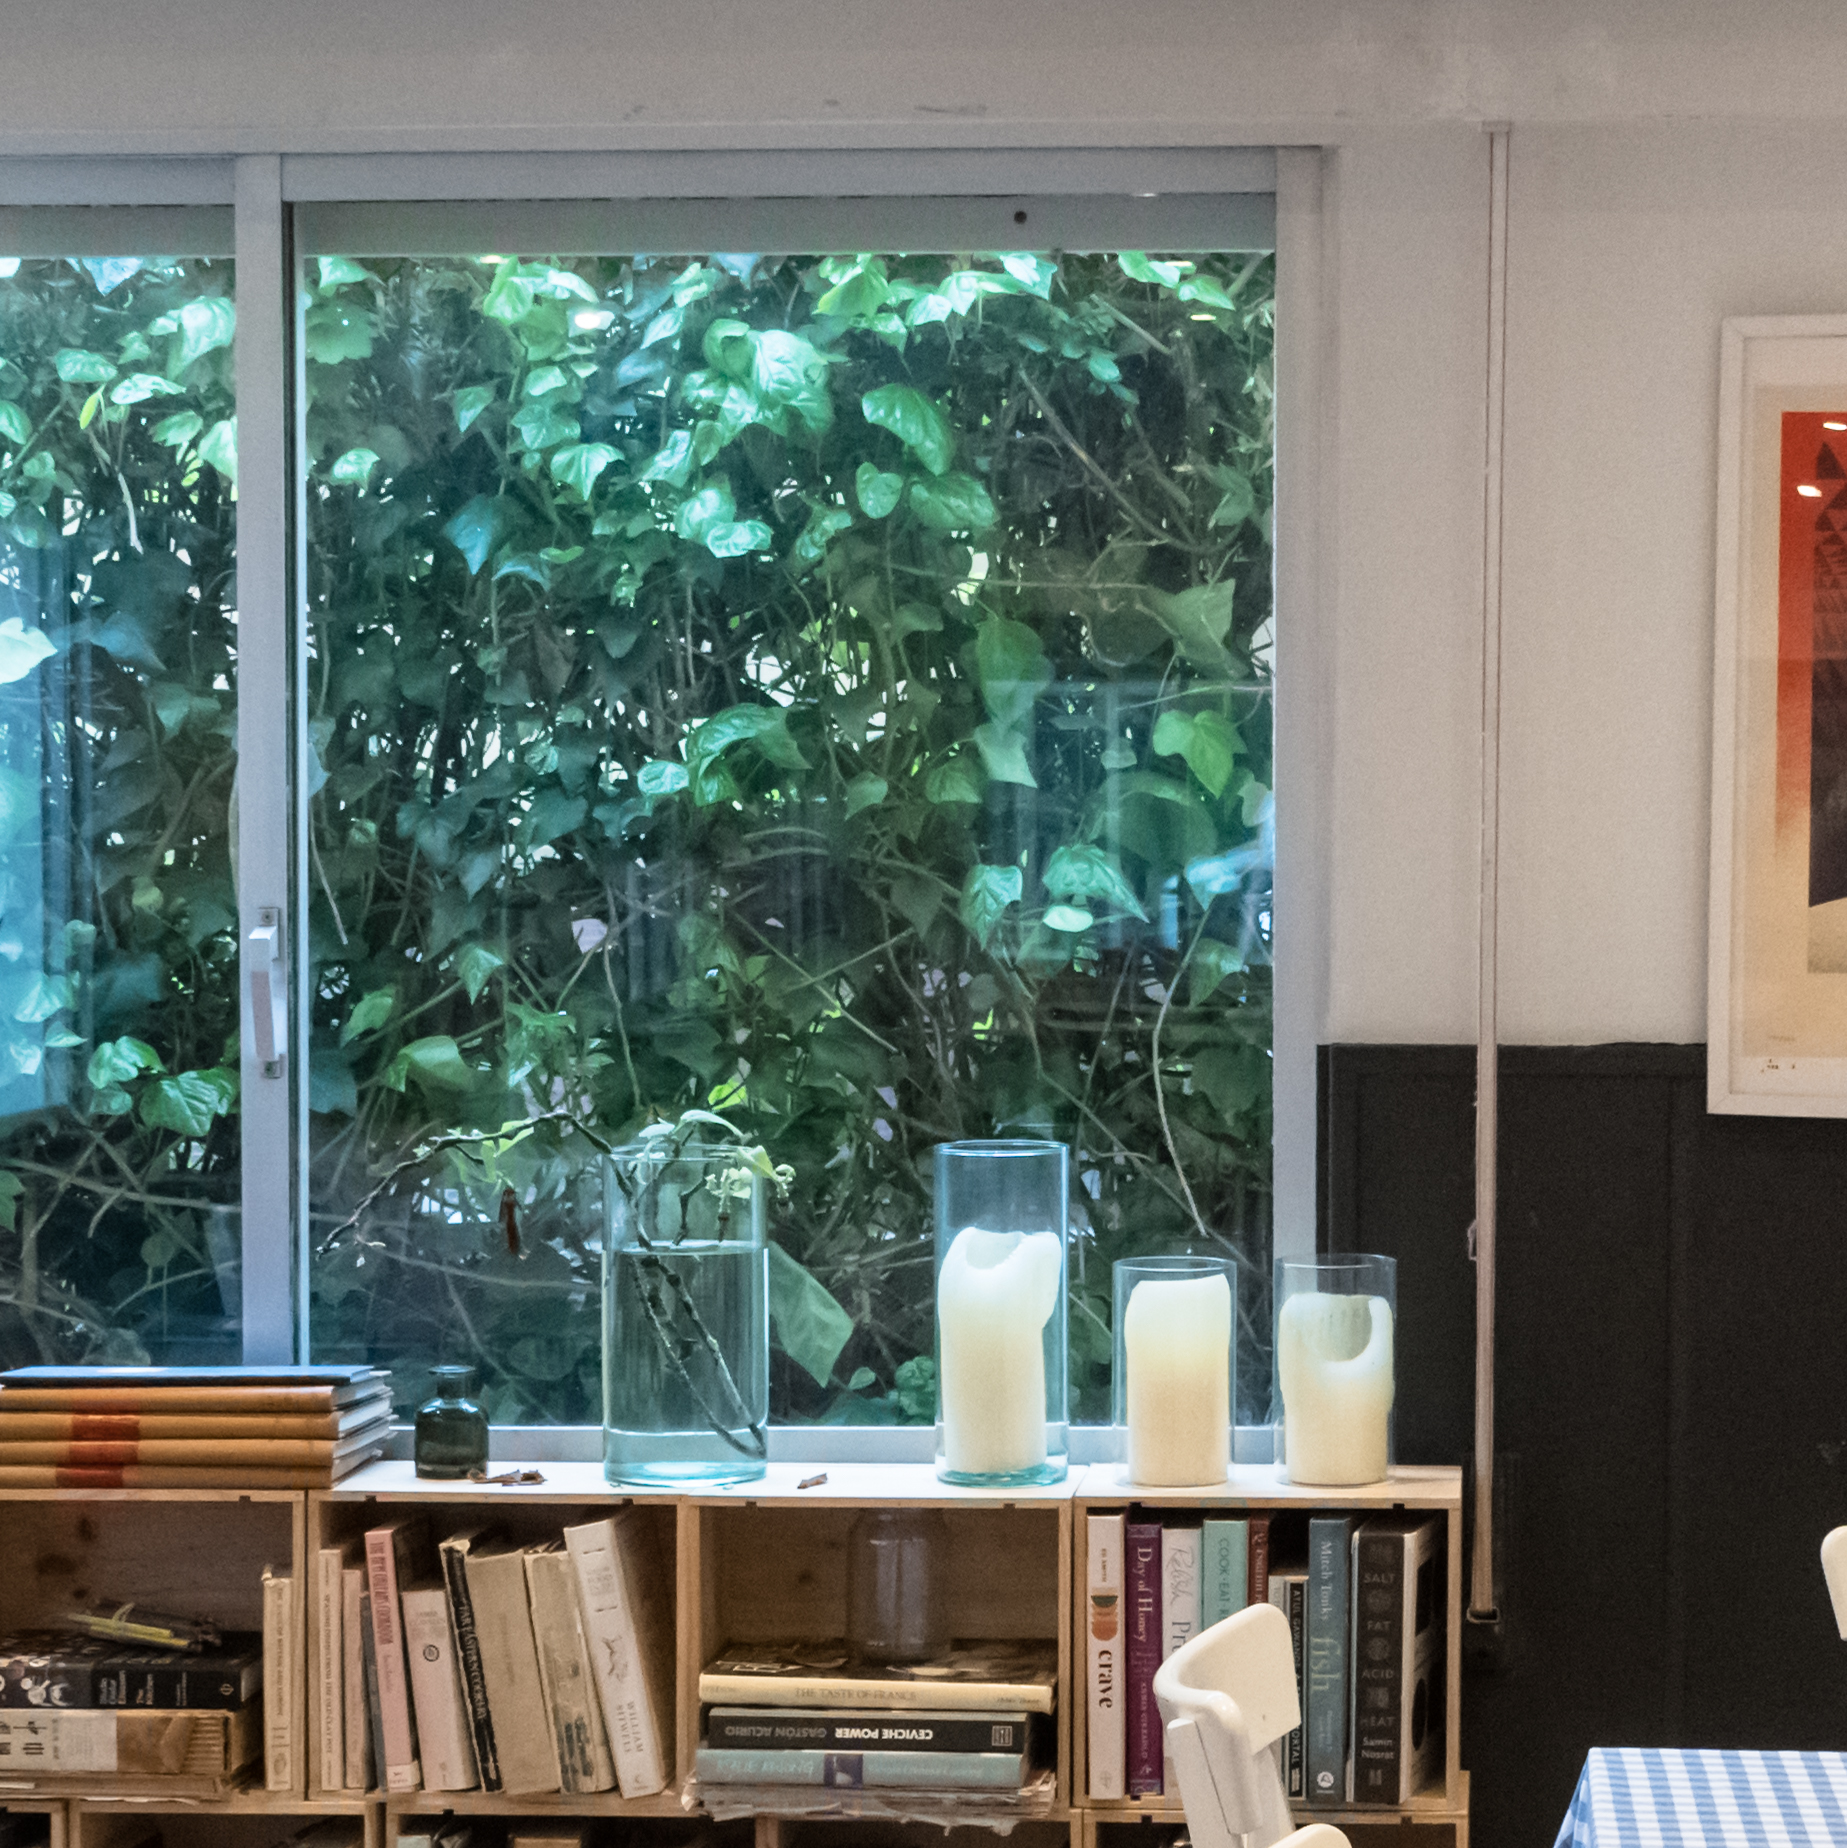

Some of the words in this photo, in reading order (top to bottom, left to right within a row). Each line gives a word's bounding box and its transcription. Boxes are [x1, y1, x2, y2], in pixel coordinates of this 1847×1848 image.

[370, 1541, 386, 1554] THE
[1134, 1546, 1153, 1576] Day
[1255, 1548, 1264, 1591] ENGLISH
[1320, 1540, 1333, 1581] Mitch
[1138, 1579, 1152, 1591] of
[1167, 1545, 1194, 1606] Relish
[1363, 1573, 1395, 1584] SALT
[373, 1573, 390, 1604] ORLEANS
[1320, 1584, 1333, 1621] Tonks
[458, 1605, 470, 1625] FAR
[1135, 1597, 1153, 1643] Honey
[375, 1605, 394, 1646] COOKBOOK
[1366, 1620, 1392, 1631] FAT
[462, 1628, 479, 1670] EASTERN
[325, 1656, 333, 1680] FROM
[1310, 1635, 1342, 1694] fish
[1361, 1668, 1395, 1679] ACID
[1096, 1649, 1115, 1708] crave
[325, 1682, 333, 1696] THE
[795, 1687, 814, 1699] THE
[325, 1715, 333, 1735] CLAY
[615, 1703, 632, 1754] SITWELL
[626, 1701, 644, 1753] WILLIAM
[725, 1726, 772, 1737] ACURIO
[1360, 1716, 1395, 1727] HEAT
[775, 1726, 828, 1740] GASTÓN
[834, 1727, 879, 1739] POWER
[881, 1728, 933, 1740] CEVICHE
[1362, 1736, 1393, 1747] Samin
[325, 1737, 333, 1753] POT
[1361, 1749, 1395, 1760] Nosrat
